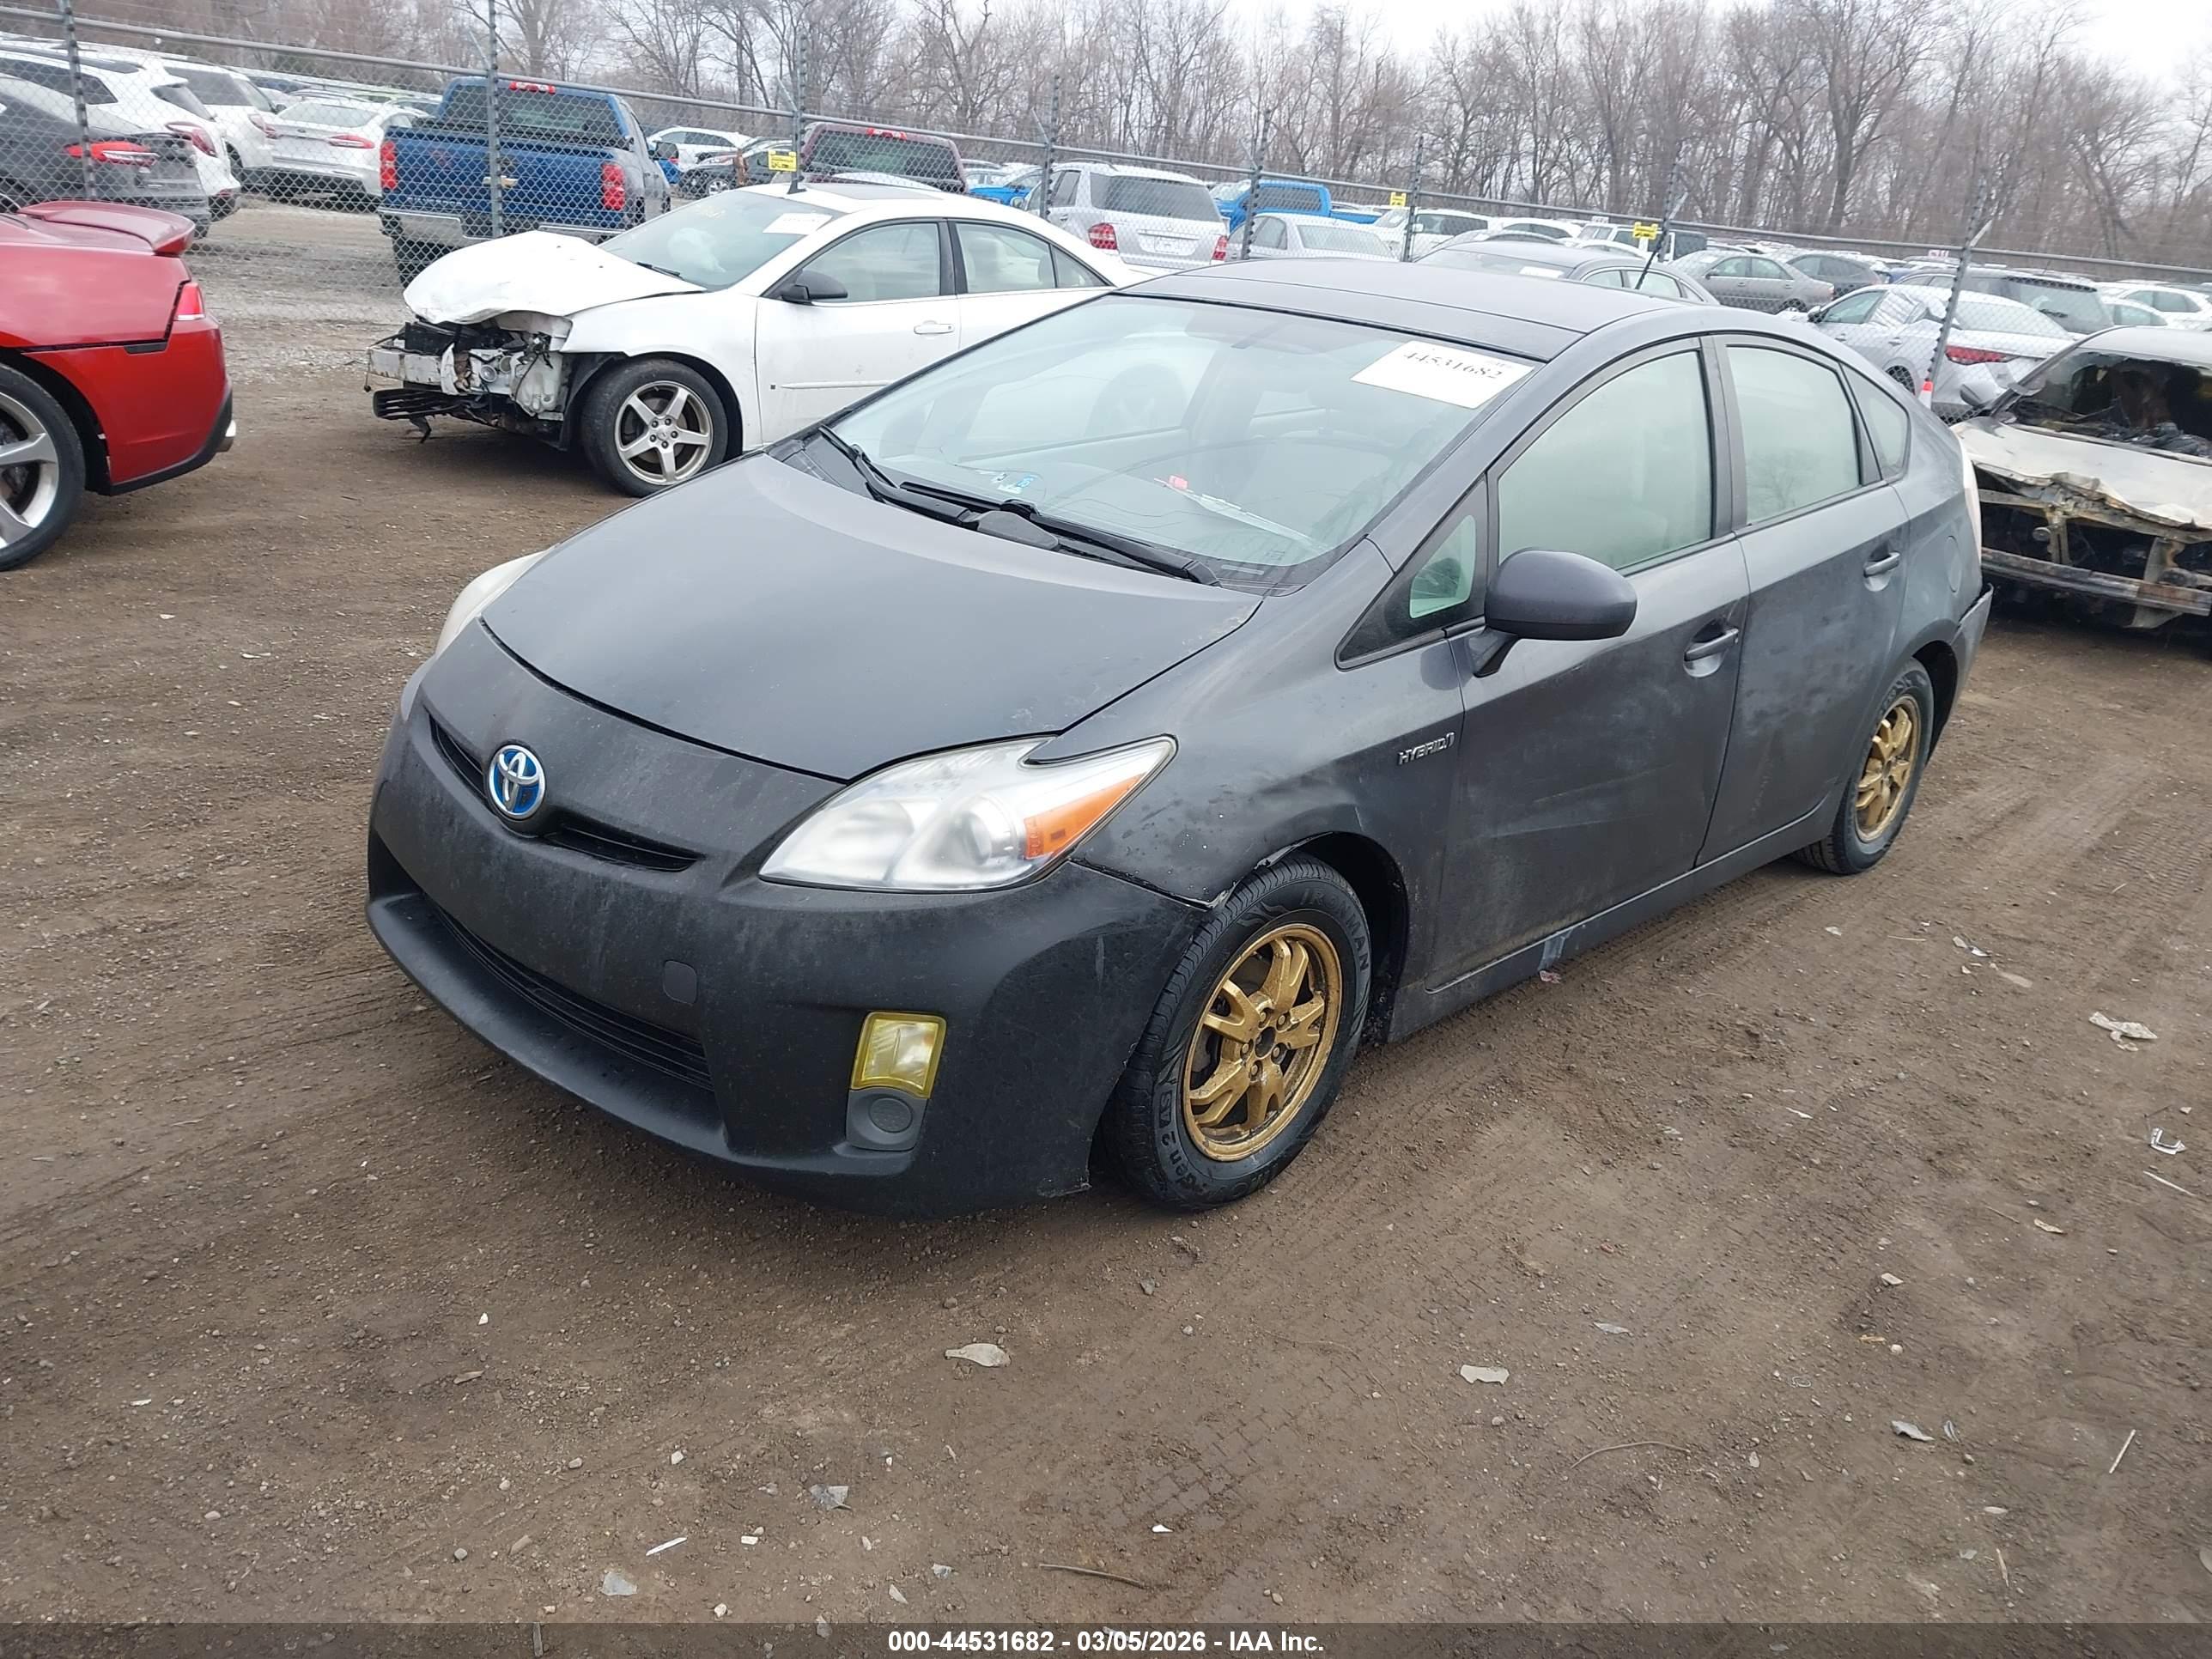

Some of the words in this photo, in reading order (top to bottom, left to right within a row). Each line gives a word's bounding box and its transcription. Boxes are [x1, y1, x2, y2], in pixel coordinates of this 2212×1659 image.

[1404, 352, 1503, 379] 44531682
[1398, 736, 1448, 765] HYBRID
[1300, 888, 1370, 971] IRONMAN
[1159, 1091, 1173, 1127] AS
[1161, 1130, 1176, 1146] 2
